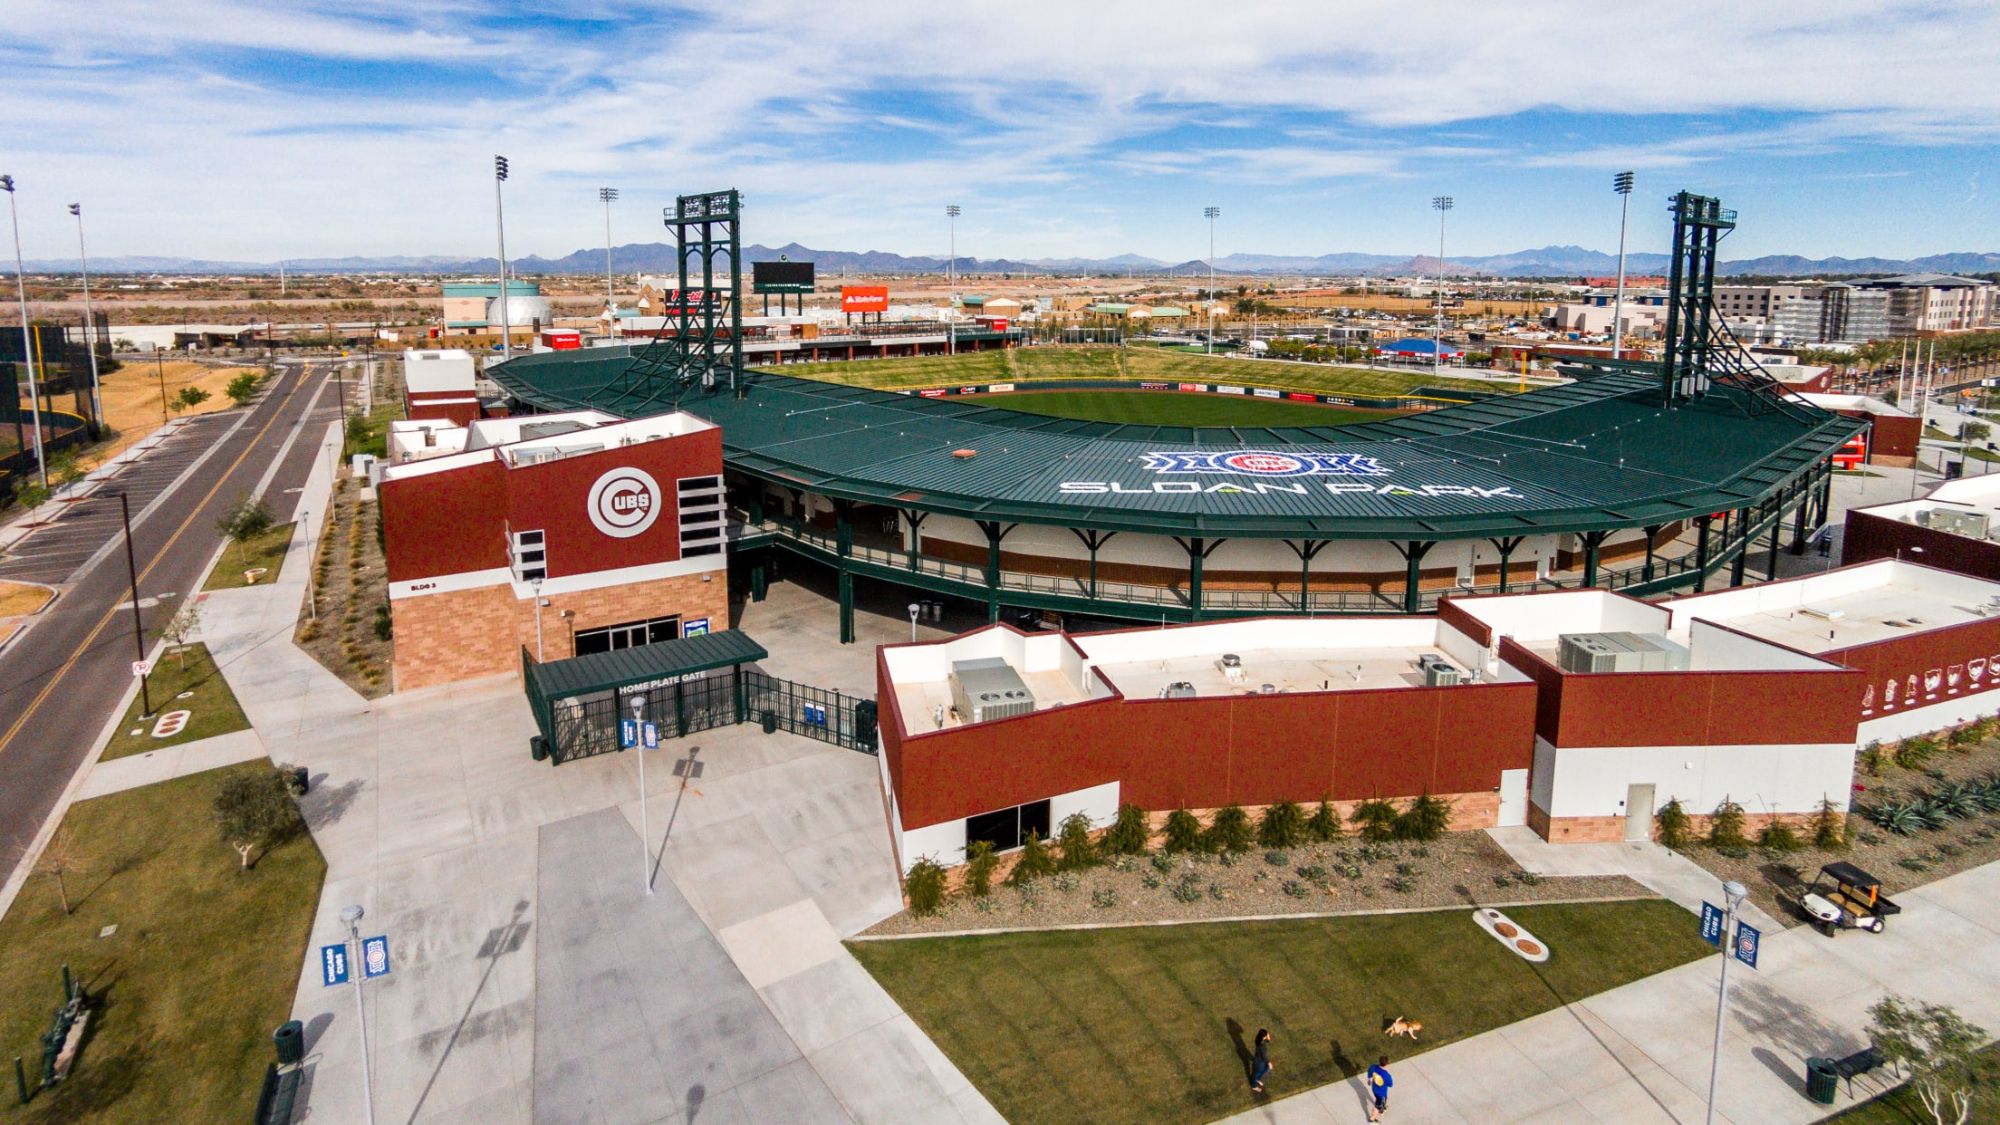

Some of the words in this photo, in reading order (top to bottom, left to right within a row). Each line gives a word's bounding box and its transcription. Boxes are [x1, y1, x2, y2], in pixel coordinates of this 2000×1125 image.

[1058, 481, 1308, 495] SLOAN
[1325, 482, 1524, 499] PARK
[600, 478, 649, 527] CUBS
[410, 583, 431, 591] BLDG
[618, 681, 650, 695] HOME
[650, 675, 680, 688] PLATE
[681, 670, 707, 682] GATE
[1702, 906, 1712, 938] CHICAGO
[1710, 916, 1720, 936] CUBS
[326, 948, 336, 983] CHICAGO
[335, 953, 344, 975] CUBS
